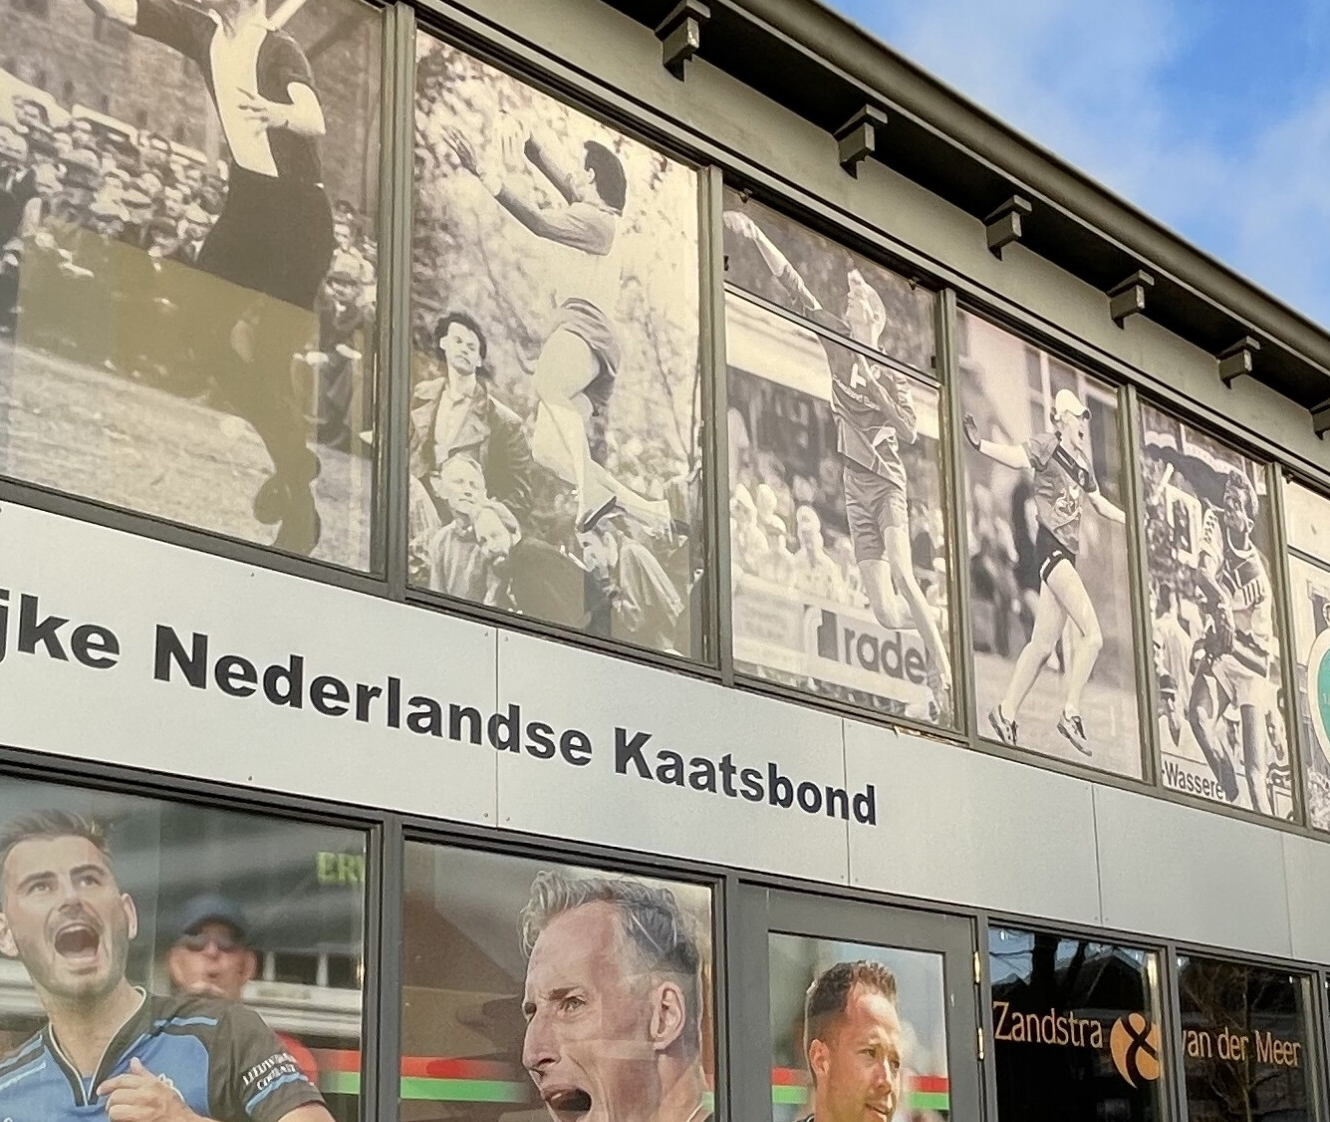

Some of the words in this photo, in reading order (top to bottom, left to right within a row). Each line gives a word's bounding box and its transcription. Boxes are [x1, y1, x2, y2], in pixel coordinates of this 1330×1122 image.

[153, 624, 593, 766] Nederlandse
[613, 727, 878, 826] Kaatsbond
[993, 1000, 1104, 1049] Zandstra
[1217, 1026, 1248, 1062] der
[1255, 1030, 1301, 1067] Meer
